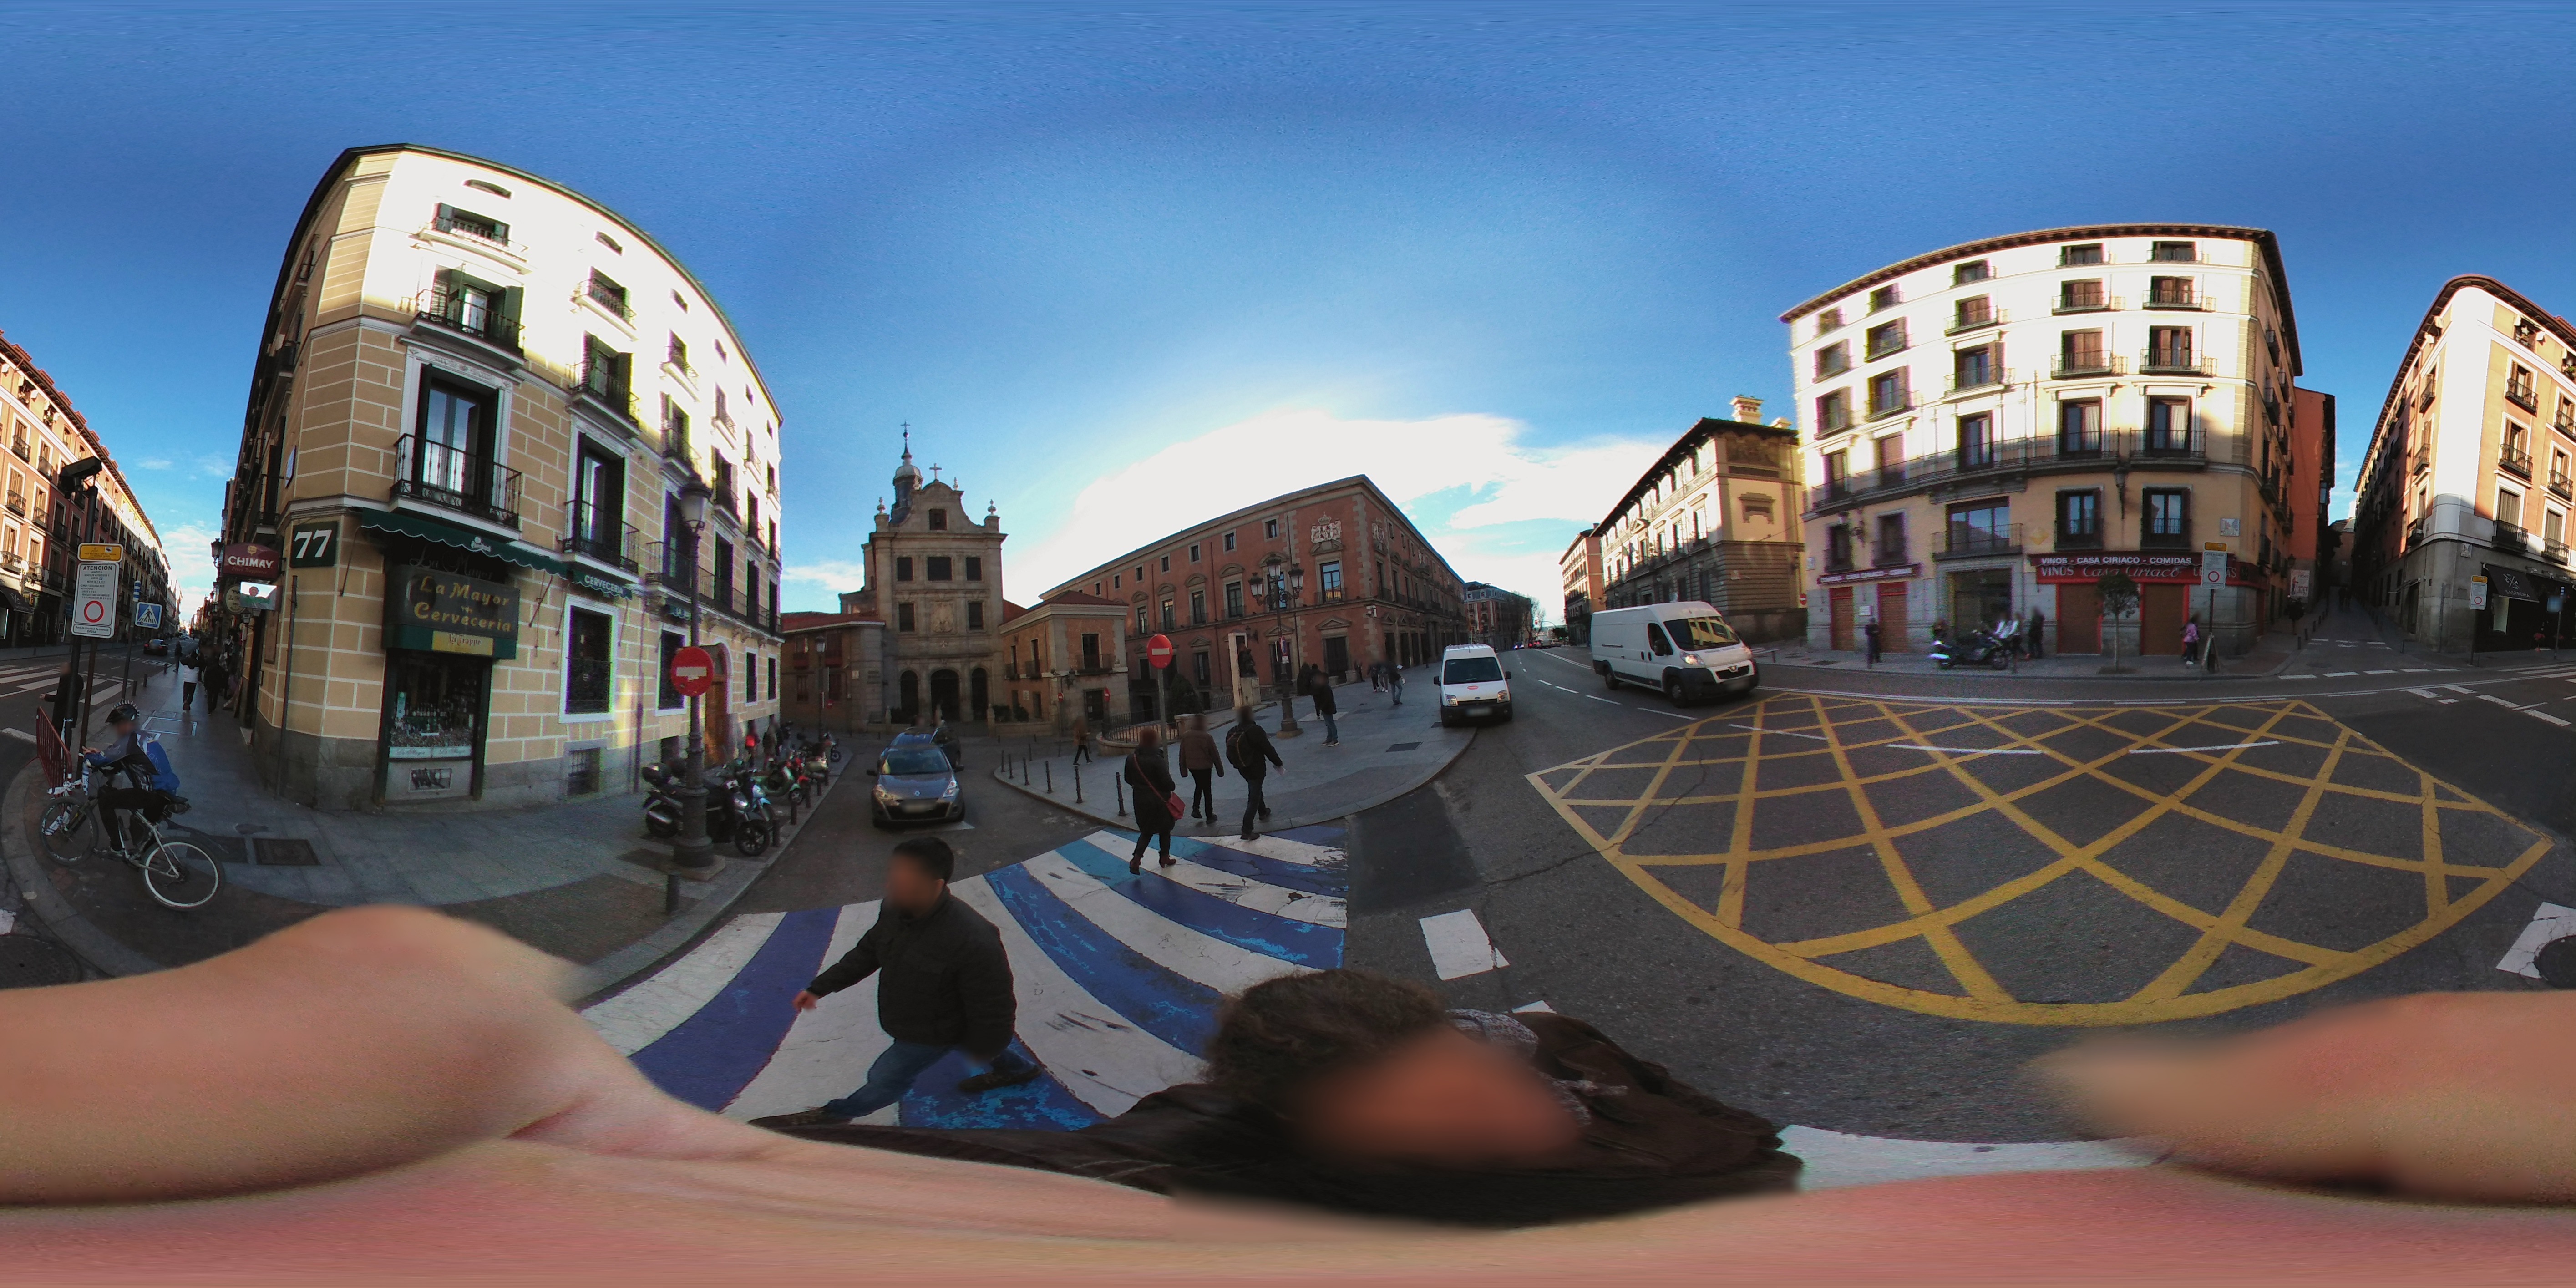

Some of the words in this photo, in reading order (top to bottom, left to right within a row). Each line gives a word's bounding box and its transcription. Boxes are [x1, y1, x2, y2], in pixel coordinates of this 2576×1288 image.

[294, 530, 332, 559] 77
[228, 556, 274, 569] CHIMAY
[2041, 567, 2074, 576] VINOS
[2083, 566, 2120, 577] Casa
[2125, 566, 2182, 577] Ciriaco
[420, 576, 446, 595] La
[449, 582, 510, 606] Mayor
[456, 634, 482, 646] Trappe
